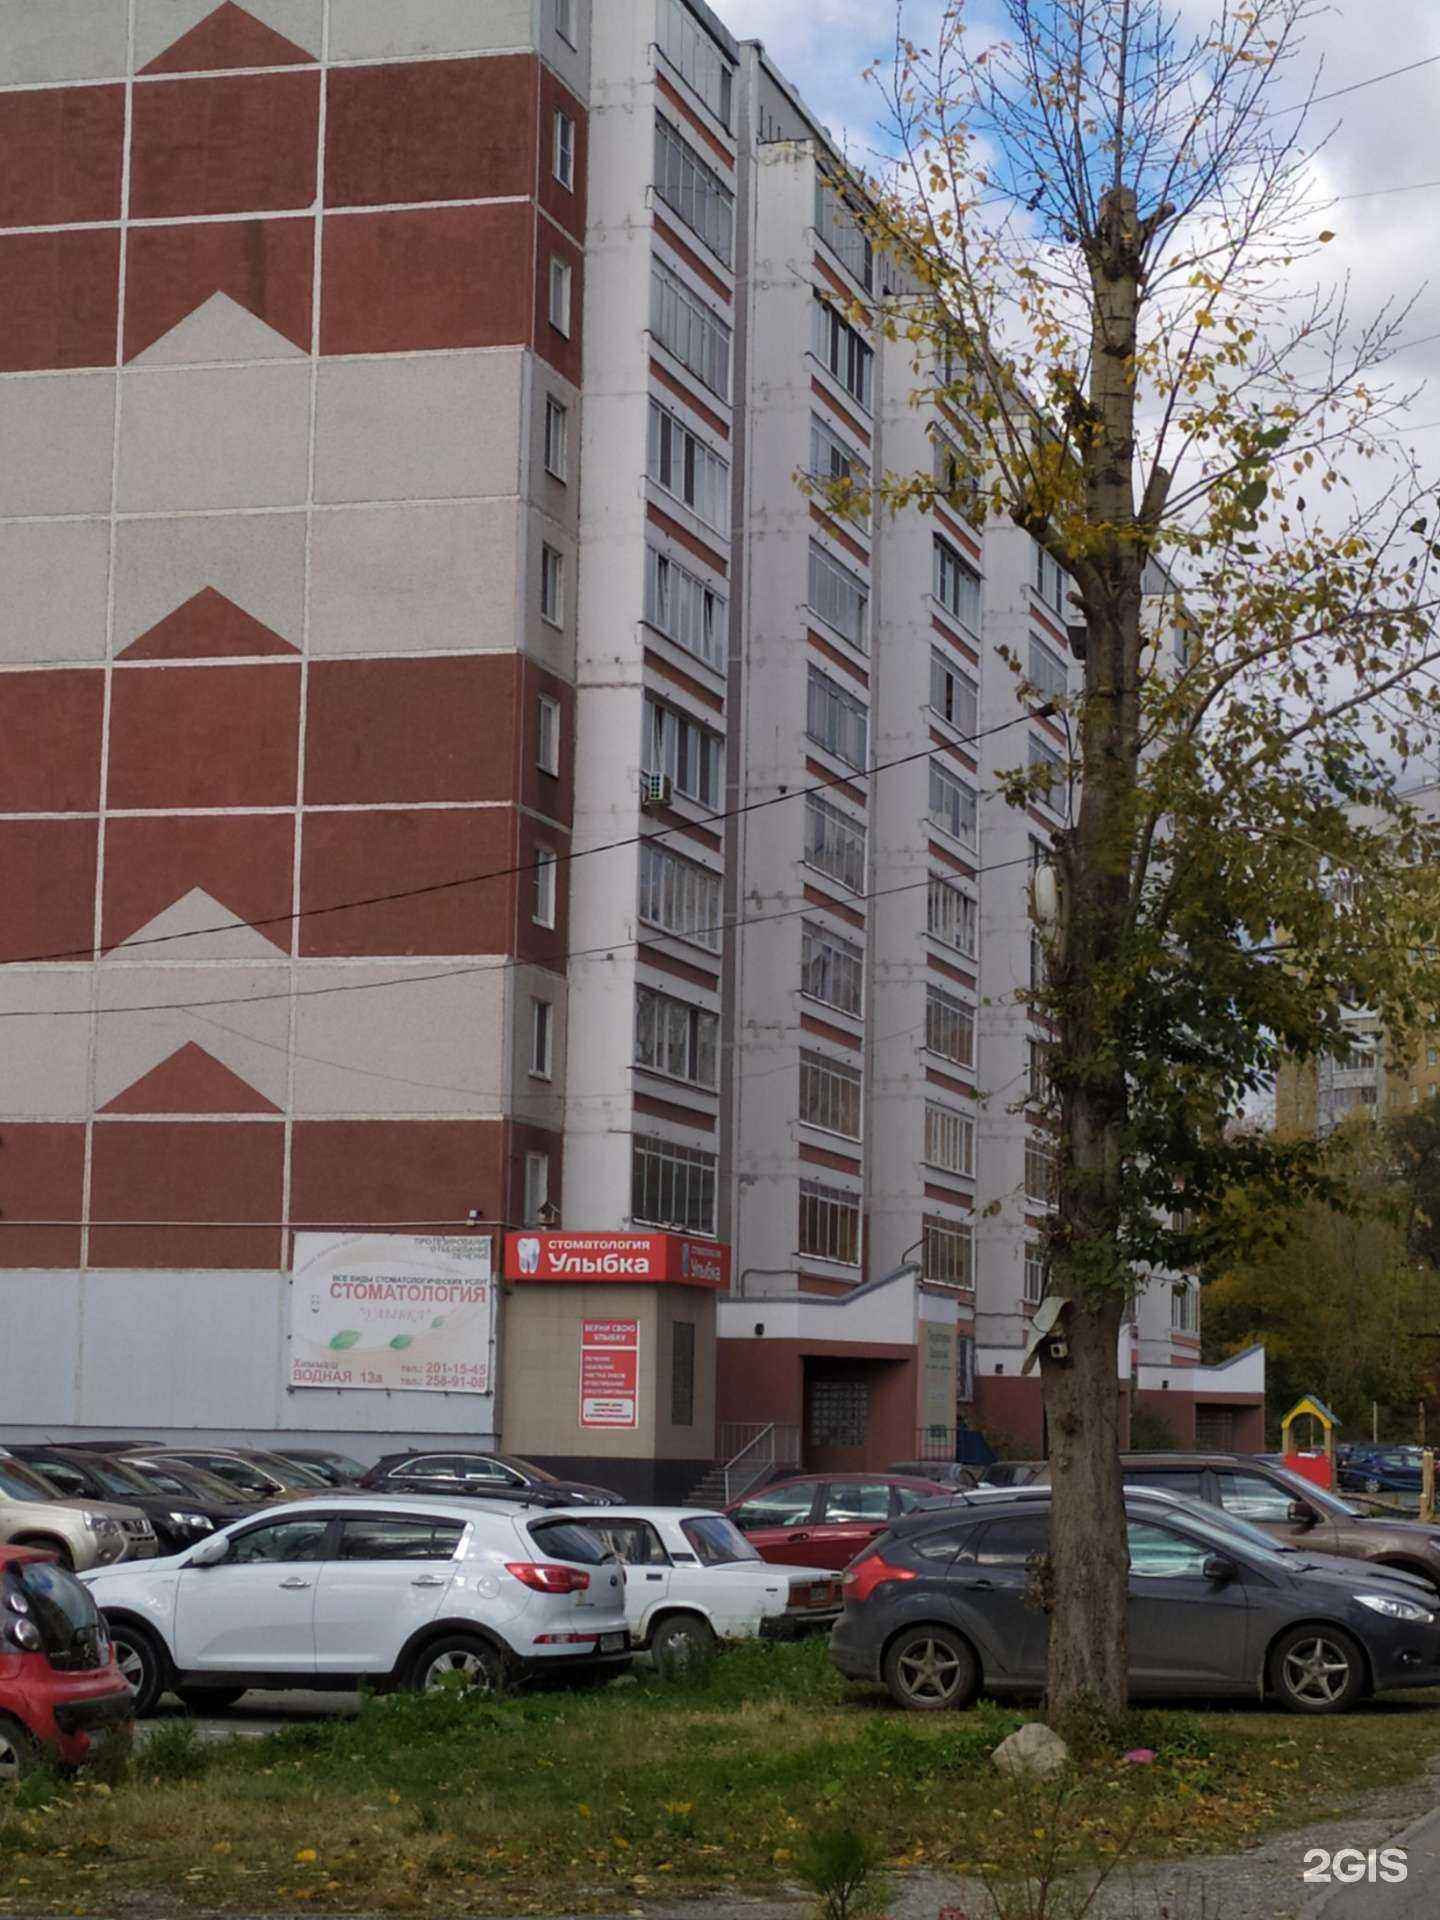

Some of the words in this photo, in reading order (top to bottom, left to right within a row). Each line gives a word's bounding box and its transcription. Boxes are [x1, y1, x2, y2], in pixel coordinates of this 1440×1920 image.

[548, 1239, 651, 1251] стоматология
[548, 1253, 650, 1274] Улыбка
[330, 1283, 486, 1303] СТОМАТОЛОГИЯ
[293, 1369, 352, 1383] ВОДНАЯ
